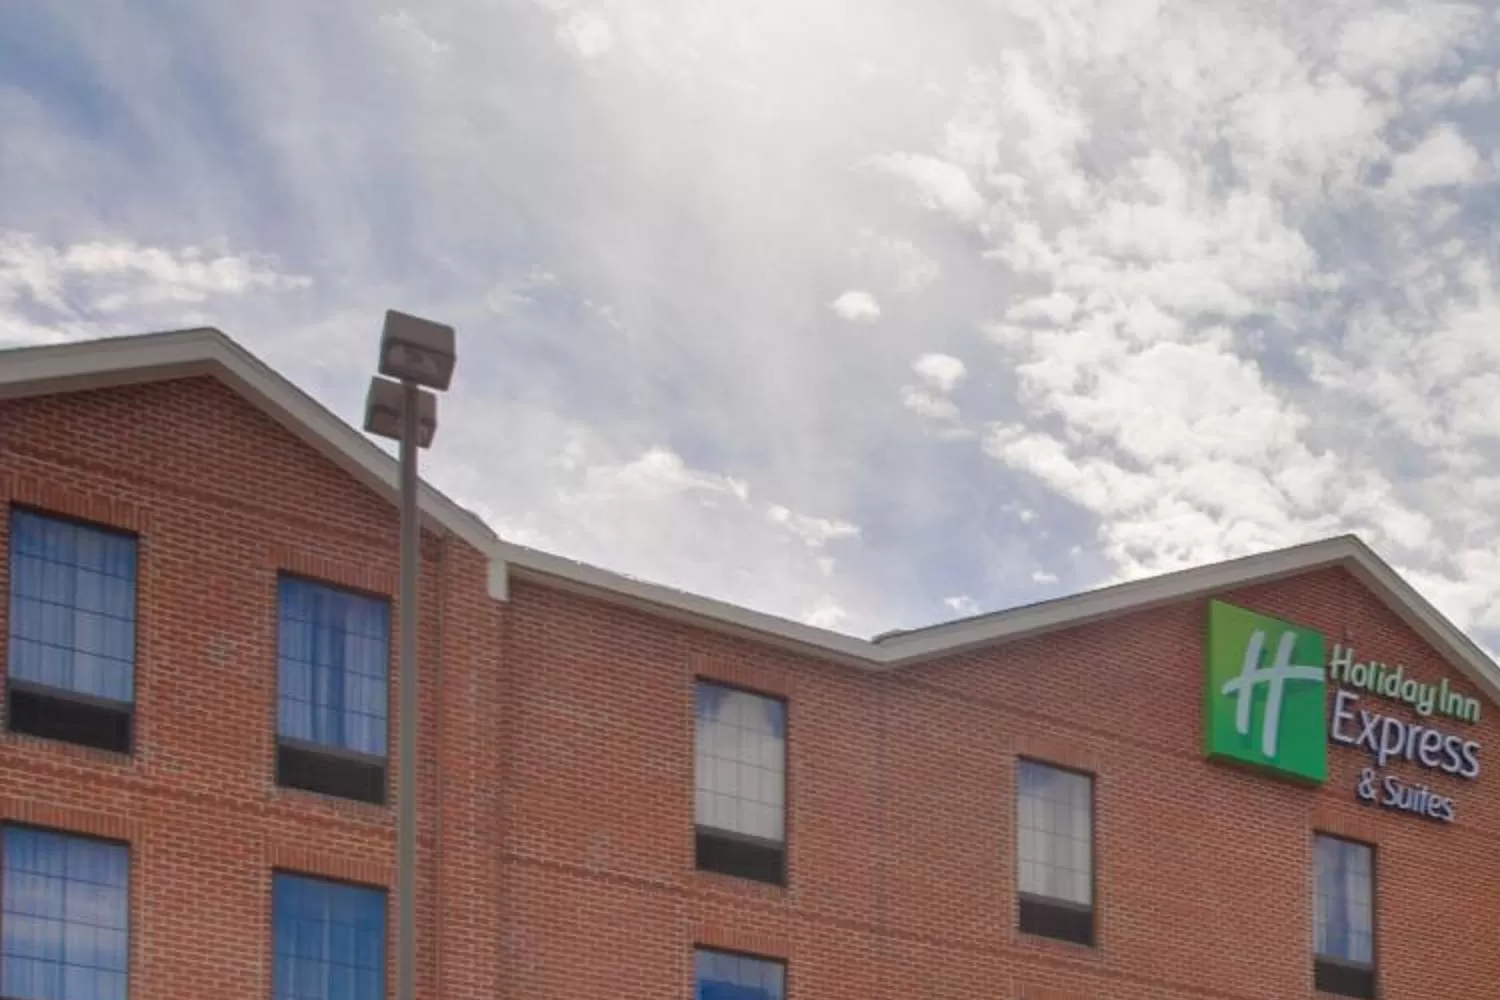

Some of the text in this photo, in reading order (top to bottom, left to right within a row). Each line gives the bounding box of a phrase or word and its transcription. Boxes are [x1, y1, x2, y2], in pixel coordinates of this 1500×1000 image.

[1329, 644, 1481, 722] Holiday Inn
[1331, 689, 1481, 779] Express
[1358, 767, 1456, 822] & Suites
